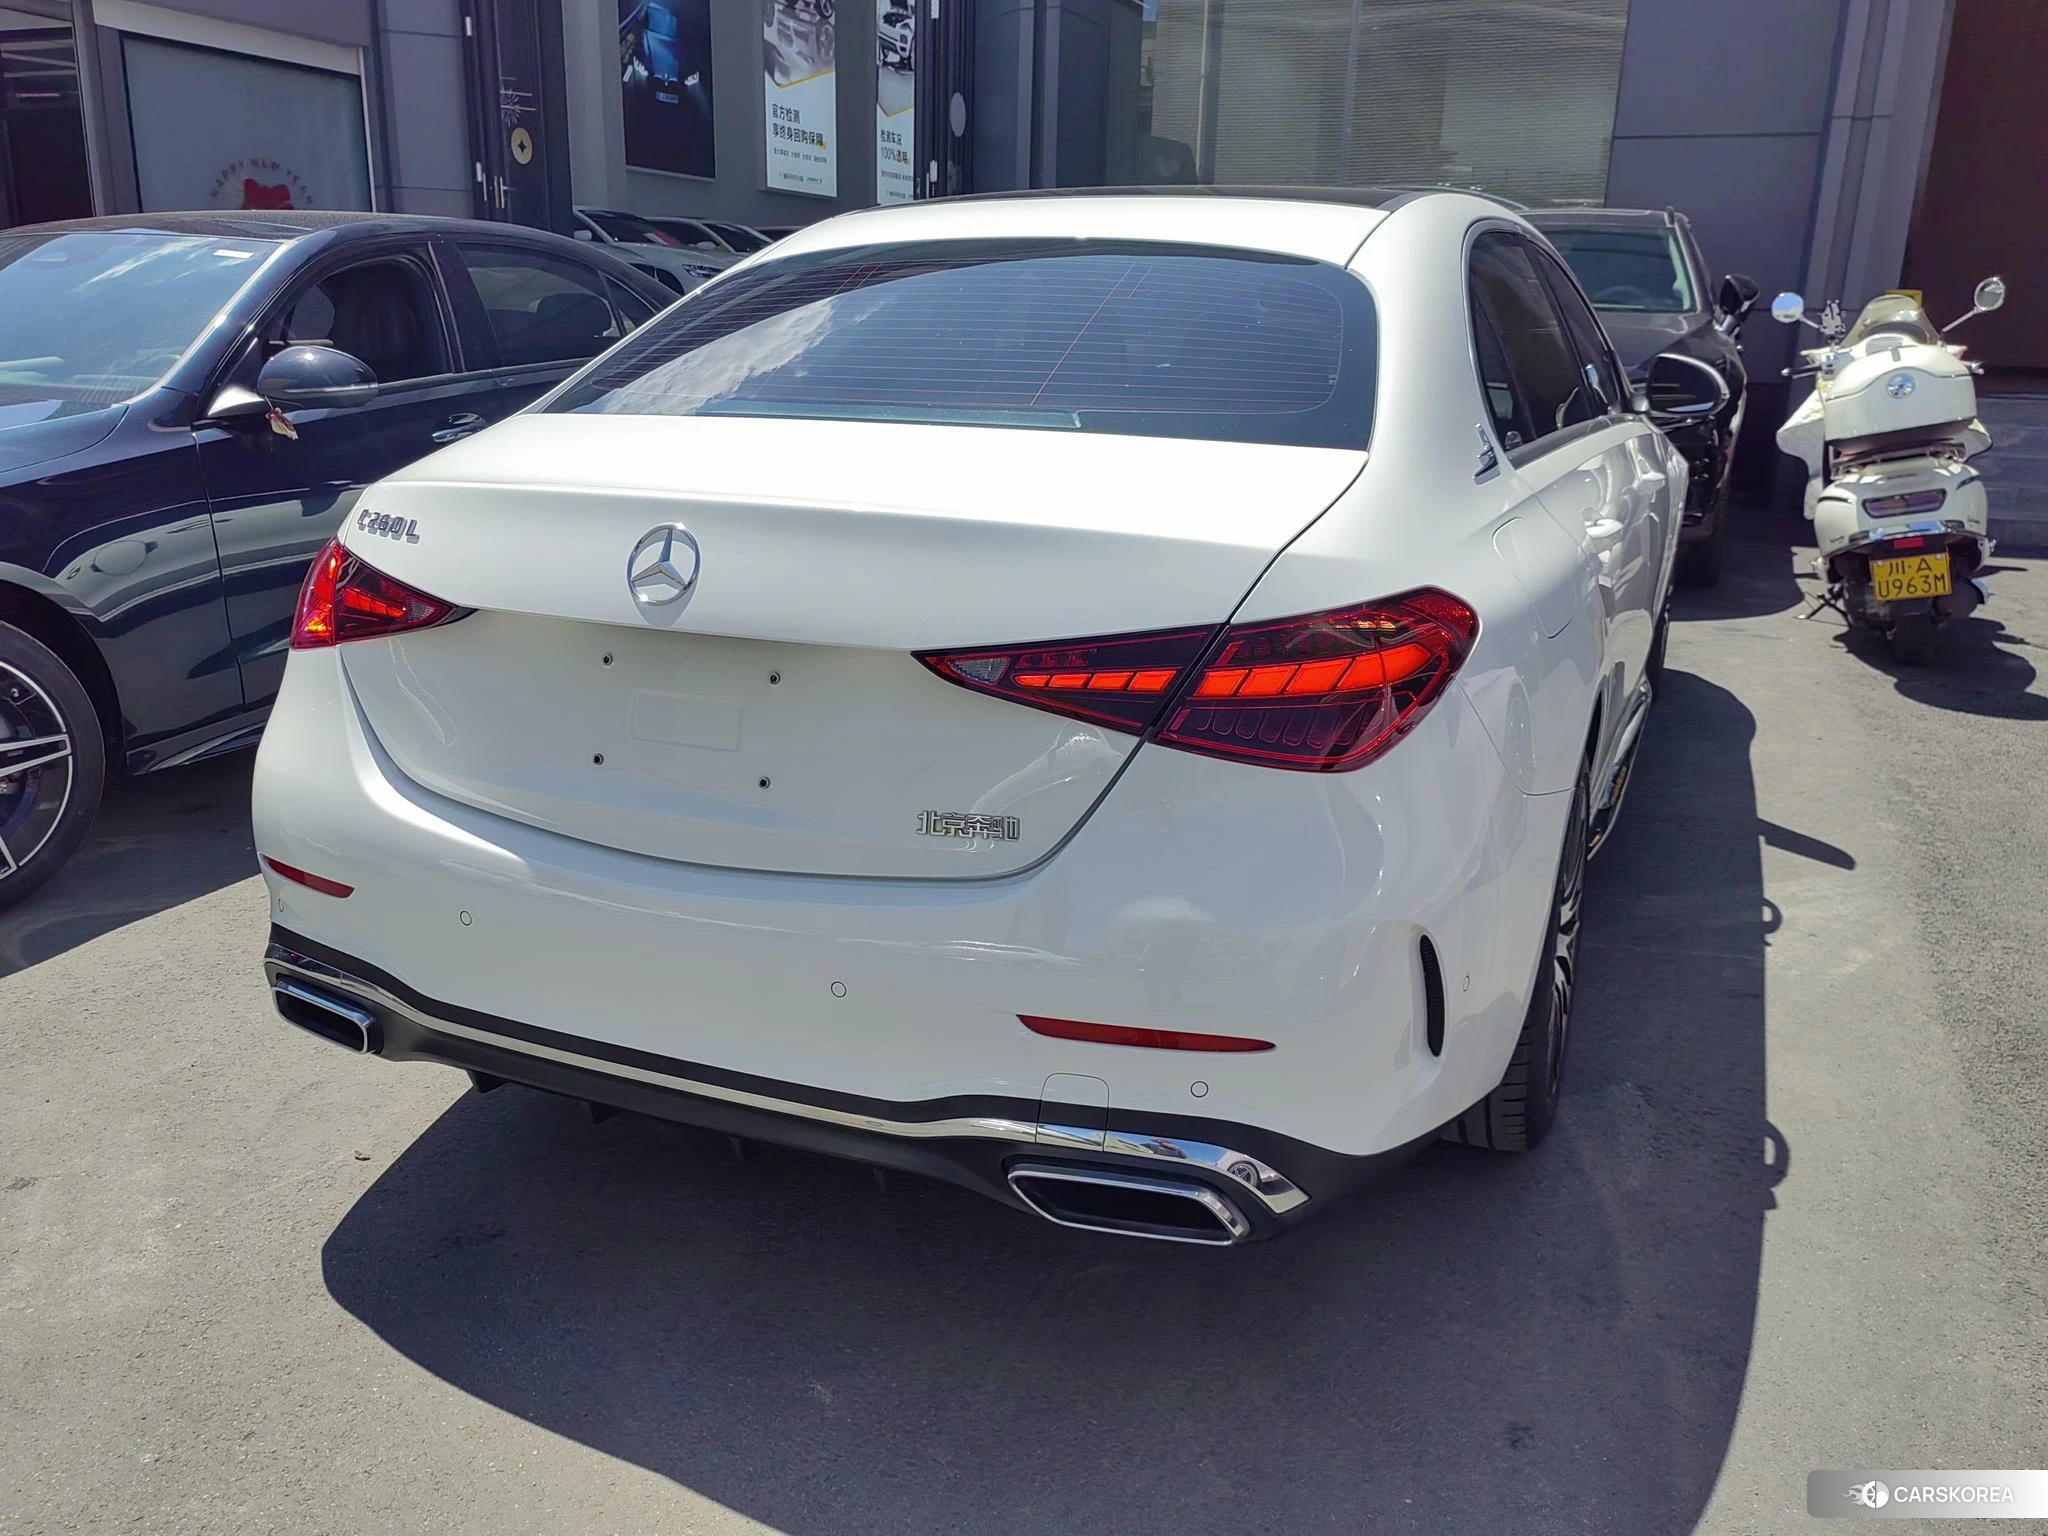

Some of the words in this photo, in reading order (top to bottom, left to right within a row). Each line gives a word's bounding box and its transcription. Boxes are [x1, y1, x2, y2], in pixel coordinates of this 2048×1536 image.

[772, 103, 800, 124] 官方检测
[209, 160, 244, 198] HAPPY
[250, 158, 280, 171] NEW
[1878, 573, 1946, 598] U963M
[916, 809, 1021, 842] 北京奔驰
